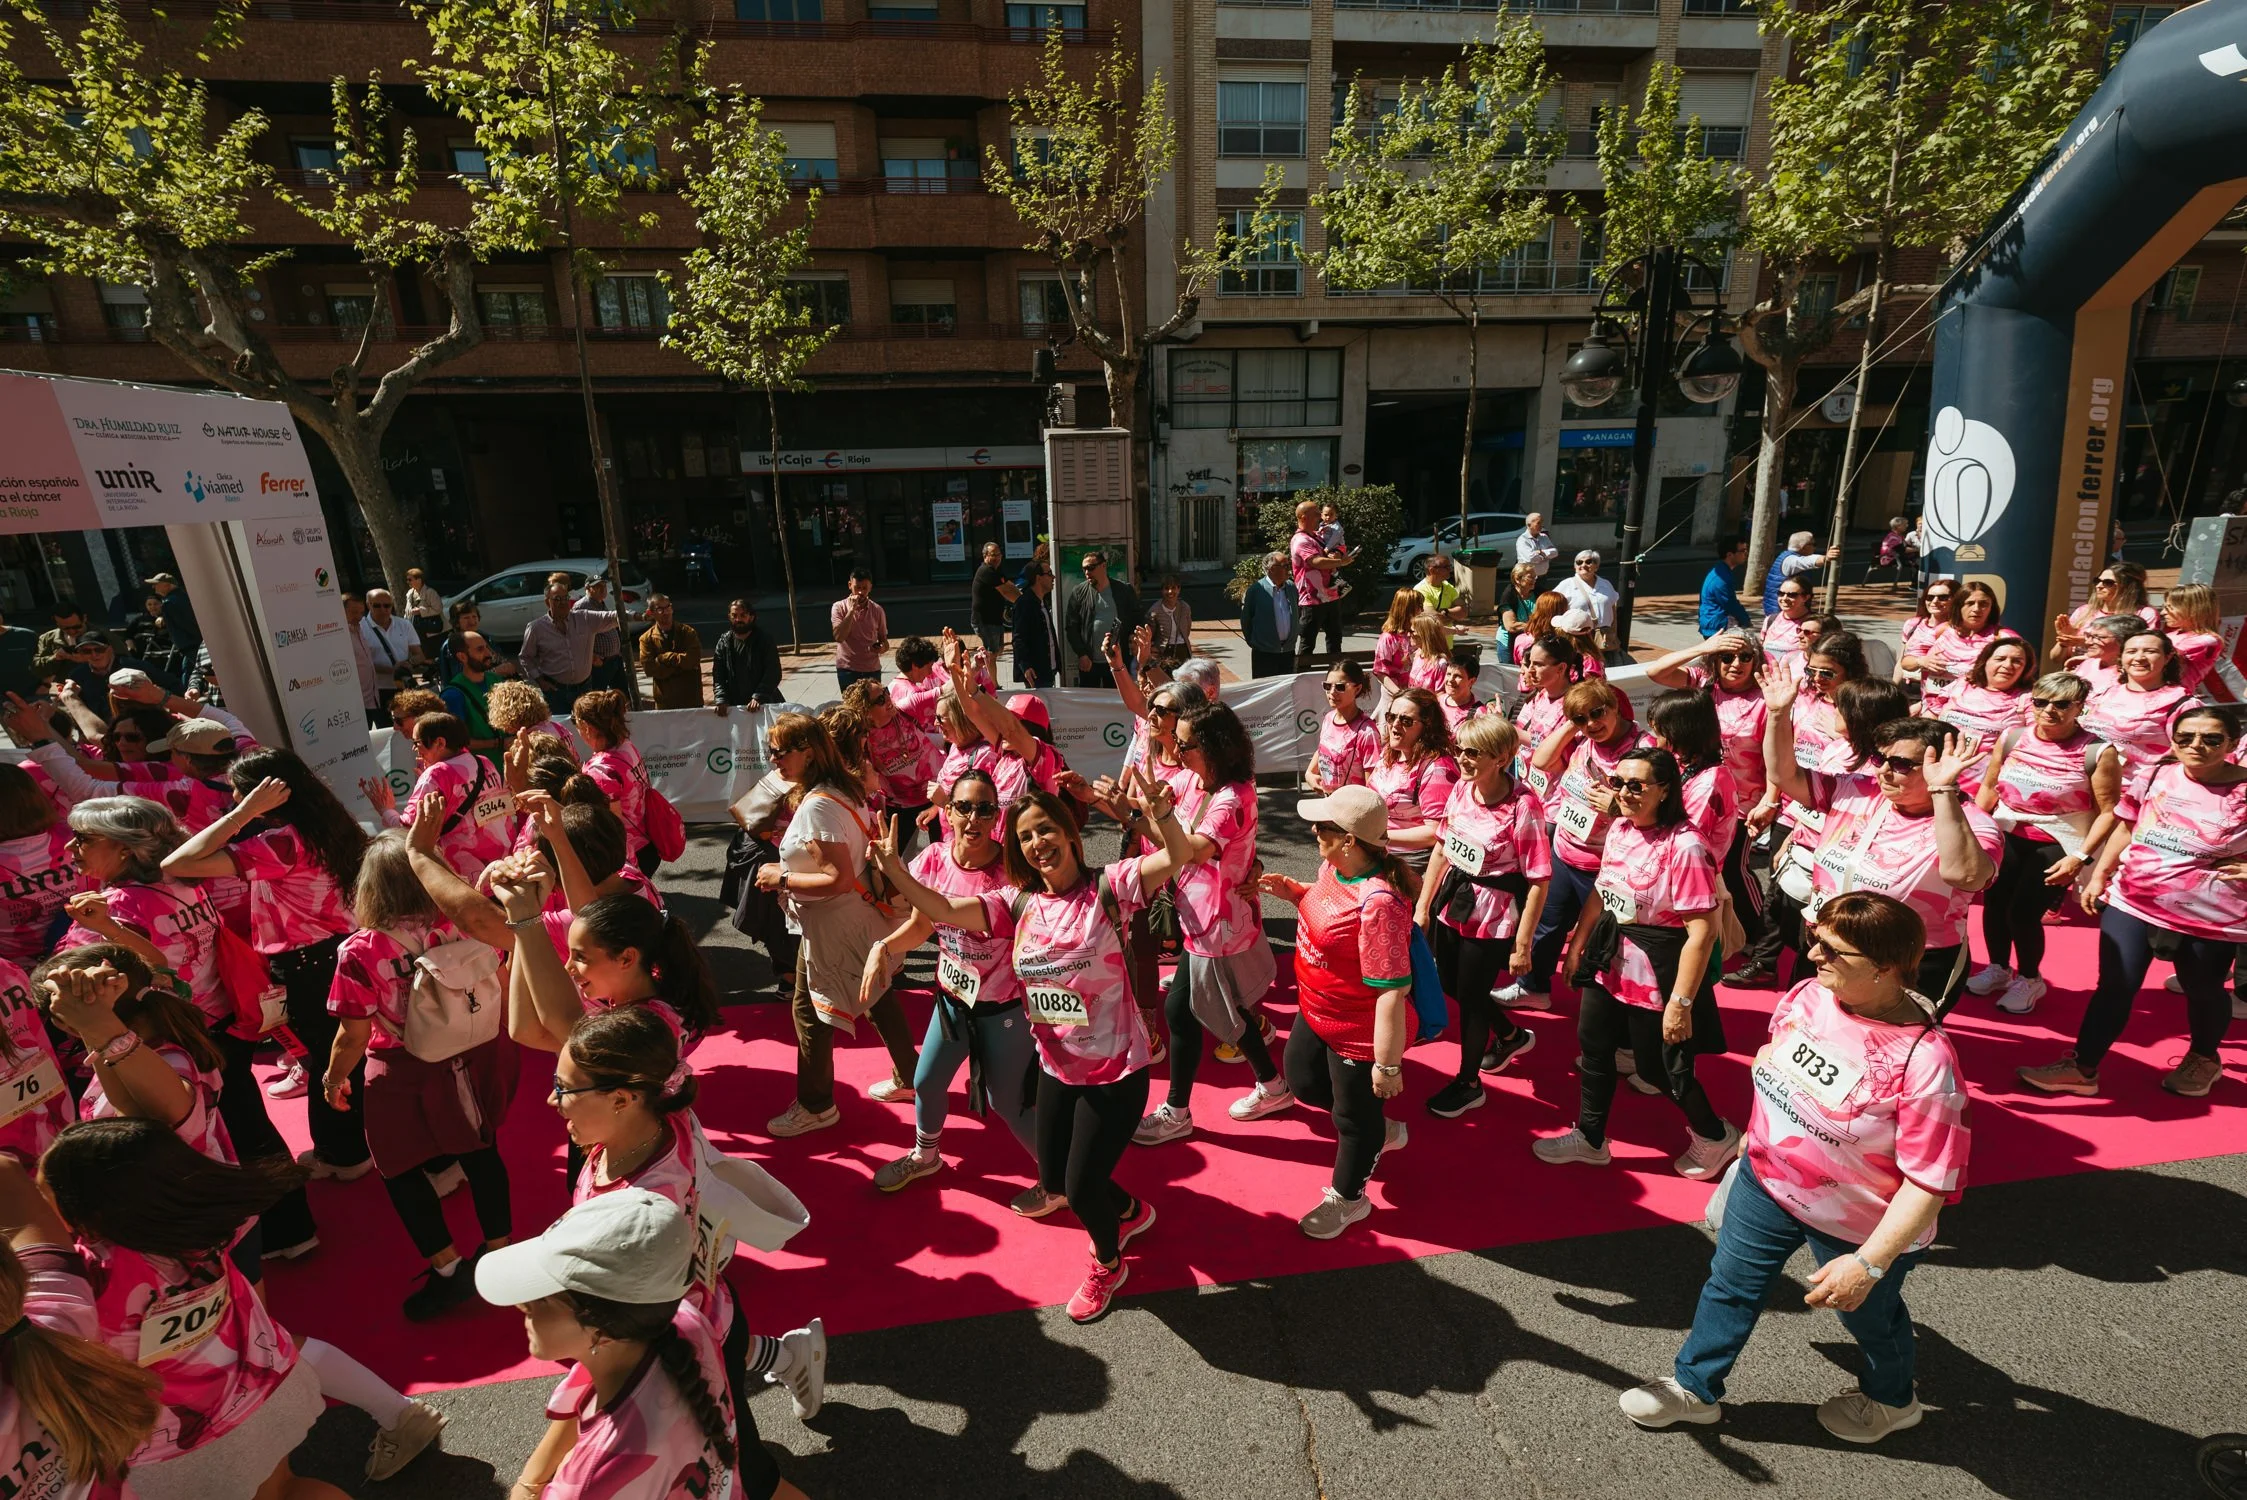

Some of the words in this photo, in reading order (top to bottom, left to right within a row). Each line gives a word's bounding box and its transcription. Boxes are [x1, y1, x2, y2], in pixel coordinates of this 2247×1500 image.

[100, 417, 157, 433] HUMILDAD
[159, 423, 182, 435] RUIZ
[252, 427, 281, 439] HOUSE
[1594, 432, 1633, 441] ANAGAN
[847, 454, 871, 465] Rioja
[29, 476, 80, 490] española
[204, 480, 244, 494] viamed
[9, 492, 22, 502] el
[23, 490, 62, 502] cáncer
[2069, 377, 2115, 617] undacionferrer.org
[9, 506, 39, 519] Rioja
[478, 799, 506, 818] 5344
[1562, 806, 1588, 829] 3148
[1449, 836, 1476, 862] 3736
[1820, 856, 1890, 891] Invegación
[1019, 957, 1035, 968] por
[1035, 955, 1047, 964] la
[1020, 959, 1092, 978] Investigación
[942, 959, 976, 994] 10881
[1031, 992, 1083, 1013] 10882
[1792, 1042, 1840, 1087] 8733
[1755, 1065, 1778, 1086] por
[1776, 1081, 1790, 1099] la
